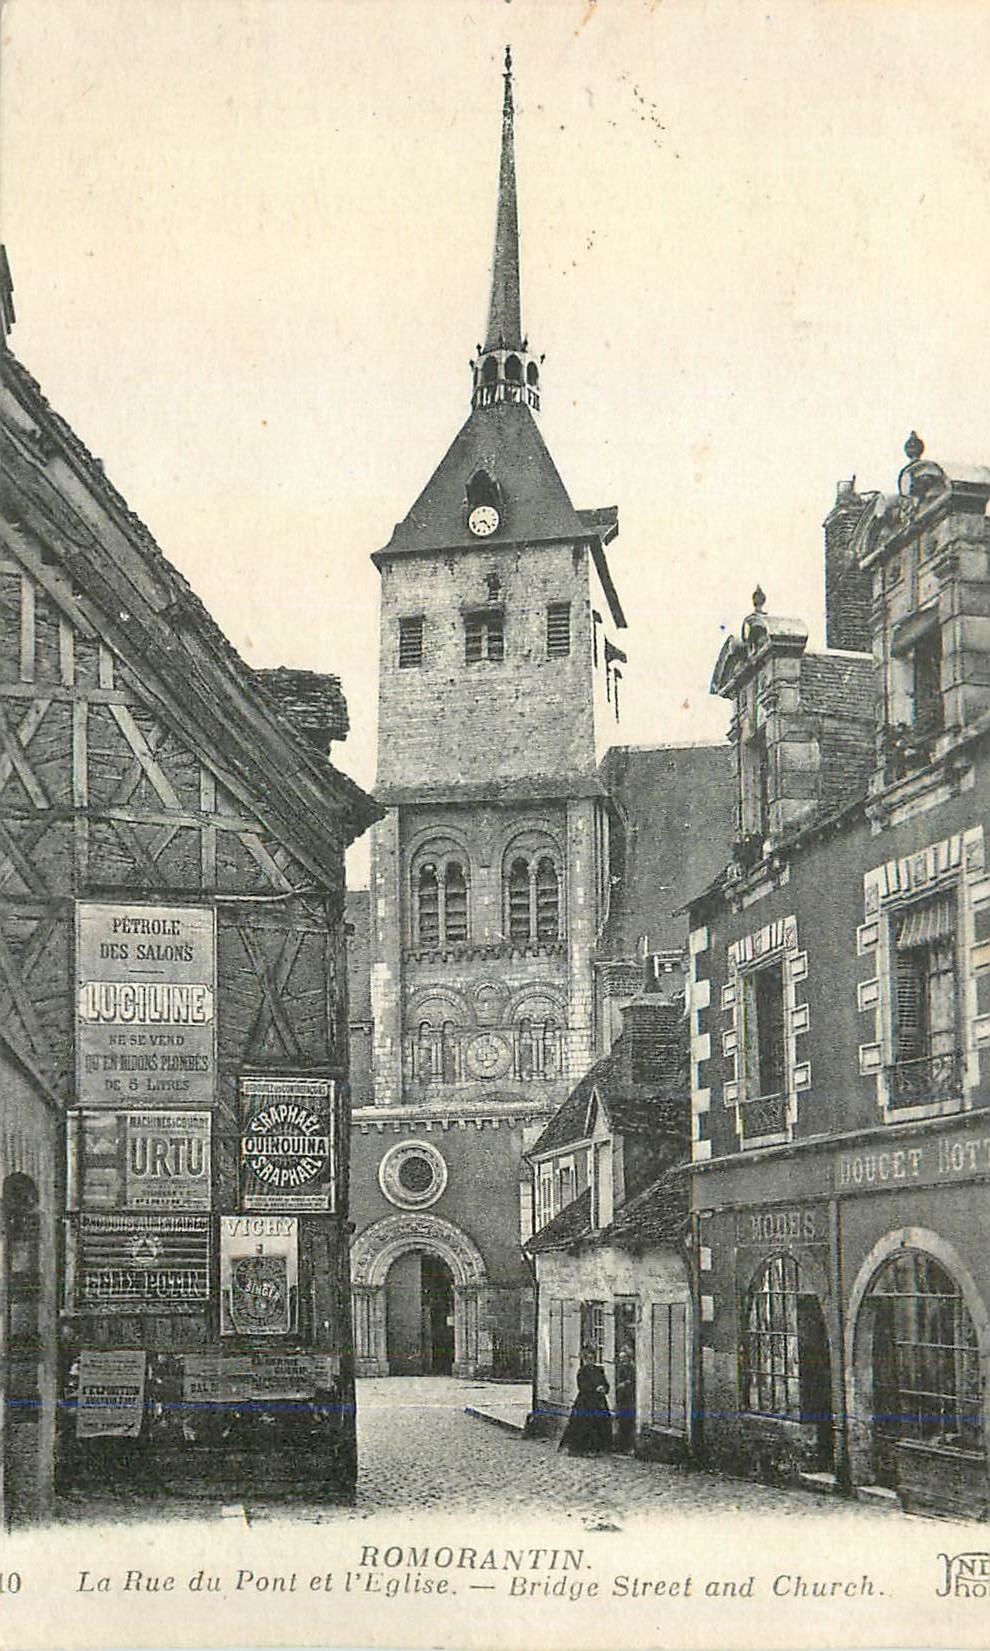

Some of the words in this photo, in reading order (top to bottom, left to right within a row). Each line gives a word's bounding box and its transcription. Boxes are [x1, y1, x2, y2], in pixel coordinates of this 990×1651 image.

[111, 915, 181, 936] PÉTROLE
[99, 943, 129, 960] DES
[136, 942, 194, 962] SALONS
[86, 984, 206, 1023] LUCILINE
[109, 1035, 126, 1046] NE
[130, 1035, 147, 1046] SE
[150, 1035, 185, 1047] VEND
[105, 1079, 121, 1091] DE
[129, 1078, 139, 1091] 5
[131, 1136, 206, 1178] URTU
[227, 1218, 295, 1237] VICHY
[751, 1212, 815, 1241] MODES
